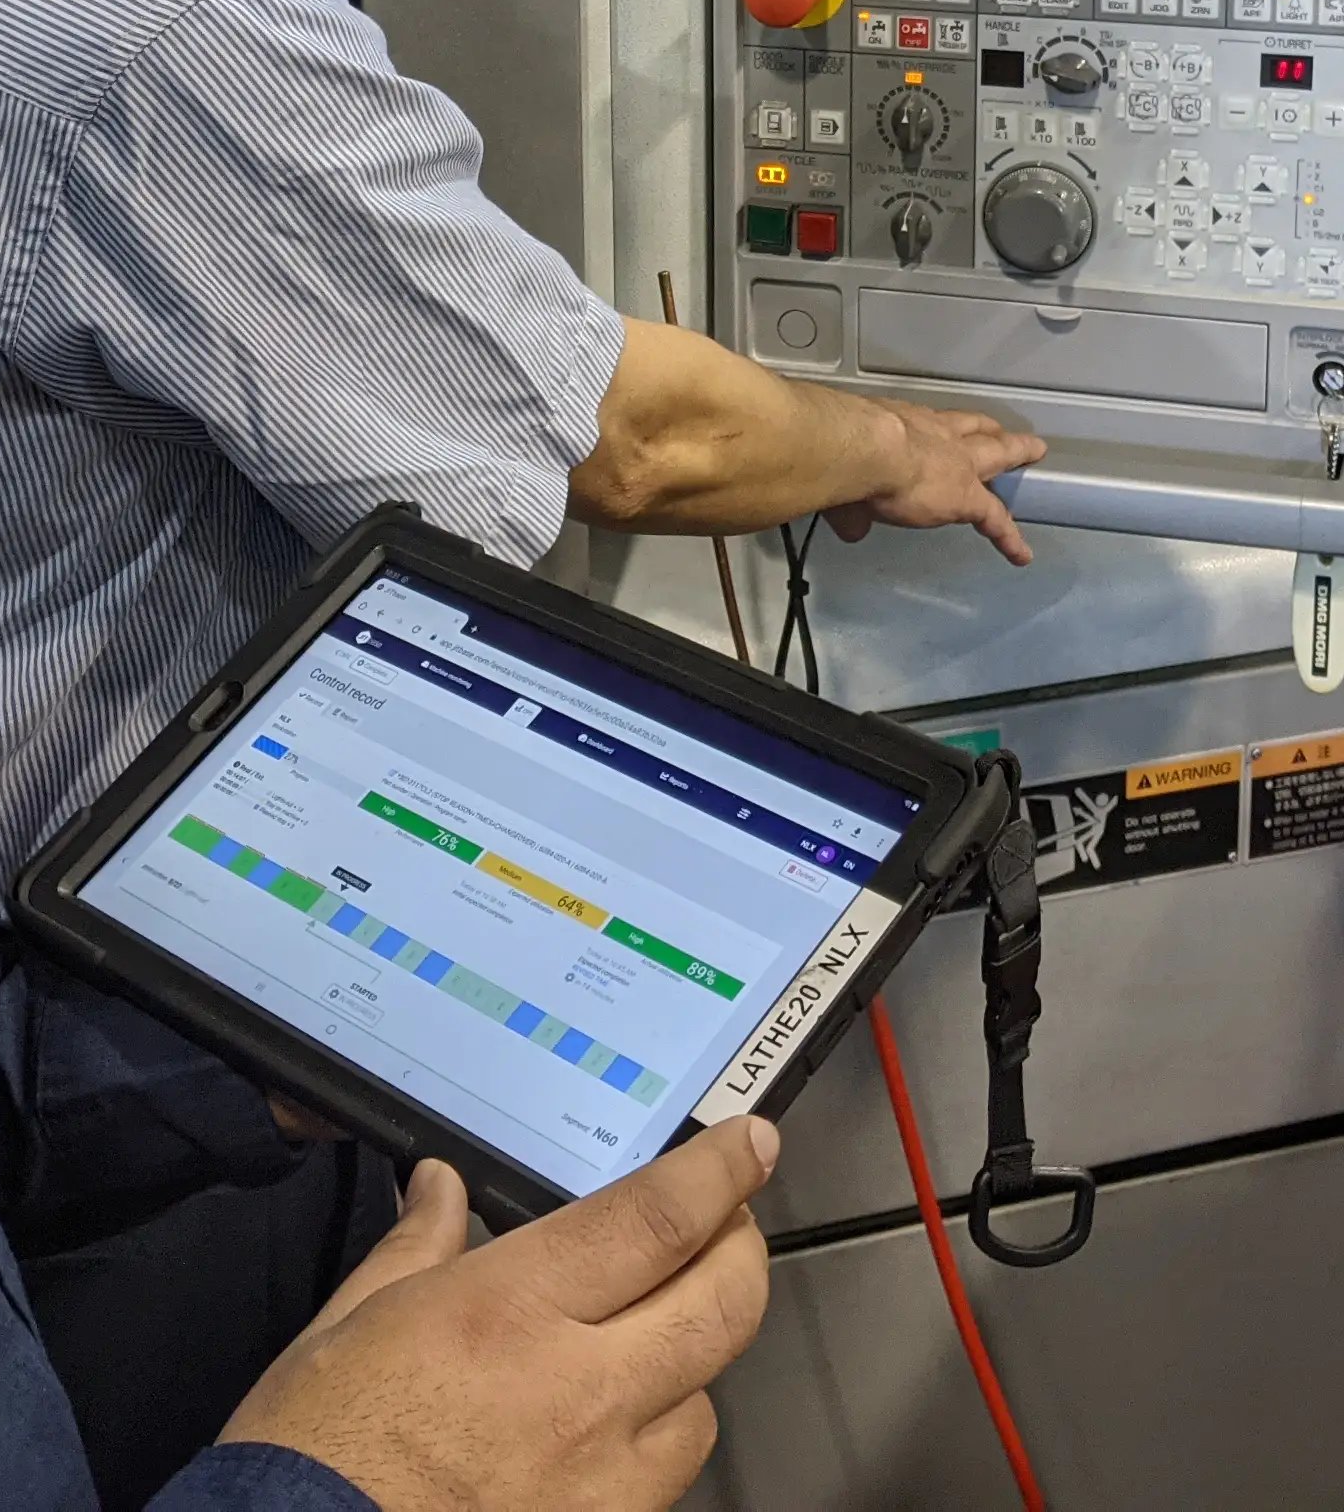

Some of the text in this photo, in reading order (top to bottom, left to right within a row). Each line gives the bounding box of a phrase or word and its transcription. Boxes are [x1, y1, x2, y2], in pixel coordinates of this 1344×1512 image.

[1108, 1, 1129, 11] EDIT
[1281, 12, 1308, 20] LIGHT
[985, 20, 1021, 32] HANDLE
[1277, 39, 1312, 49] TURRET
[1314, 584, 1328, 669] DMG MORI
[309, 668, 388, 711] Control record
[1156, 762, 1232, 786] WARNING
[382, 804, 459, 851] High 76%
[800, 839, 856, 871] NLX EN
[499, 865, 585, 917] Medium 64%
[628, 931, 717, 985] High 89%
[349, 982, 378, 1003] STARTED
[726, 923, 870, 1096] LATHE20 NLX
[592, 1125, 619, 1147] N60
